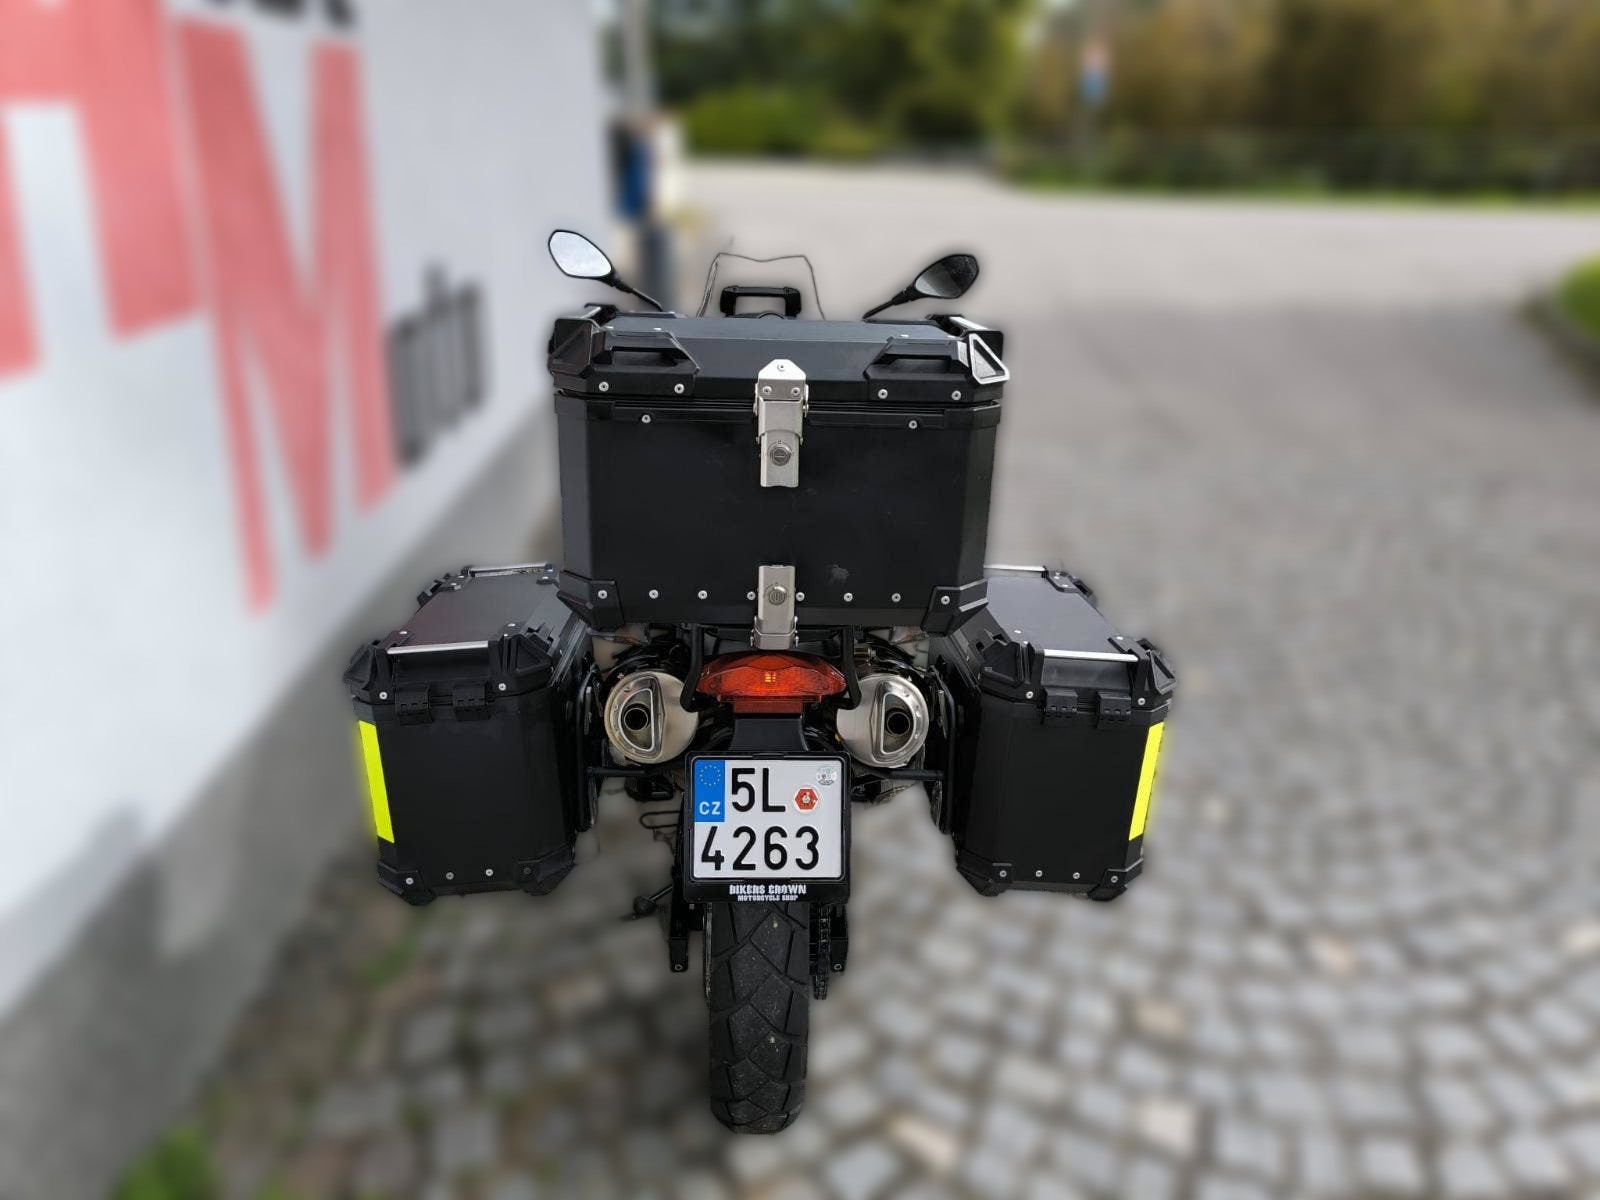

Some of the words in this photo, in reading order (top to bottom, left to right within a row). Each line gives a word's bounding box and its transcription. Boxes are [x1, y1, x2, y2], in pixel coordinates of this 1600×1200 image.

[731, 767, 786, 813] 5L
[699, 801, 721, 815] CZ
[701, 825, 820, 871] 4263
[729, 884, 766, 895] BIKERS
[768, 884, 807, 894] CROWN
